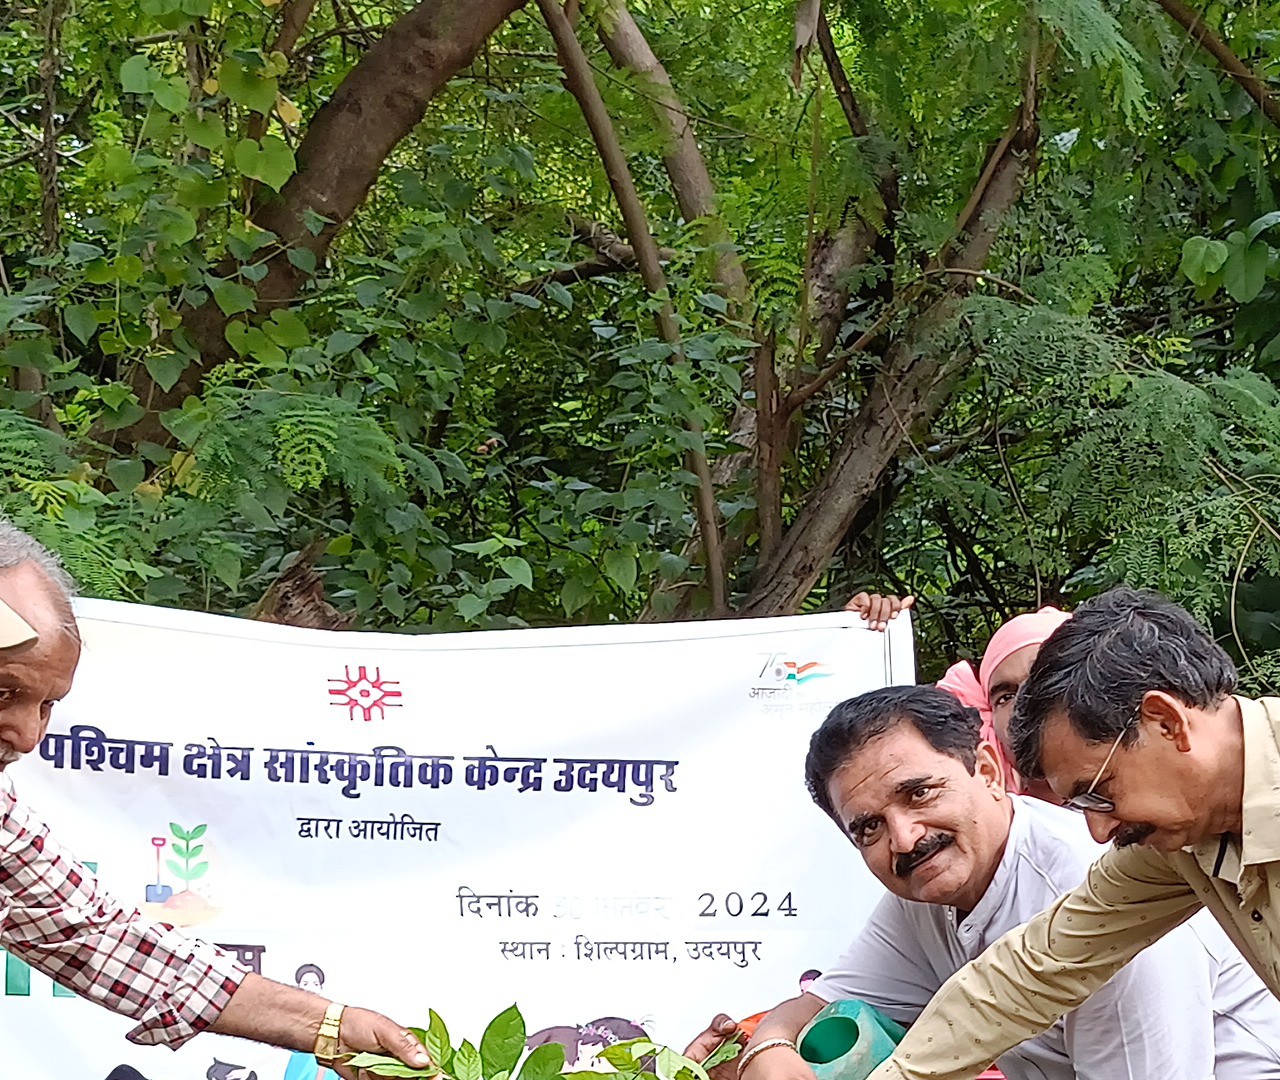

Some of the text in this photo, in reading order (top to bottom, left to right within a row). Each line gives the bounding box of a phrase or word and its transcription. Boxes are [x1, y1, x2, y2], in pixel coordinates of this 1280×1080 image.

[39, 724, 680, 807] पश्चिम क्षेत्र सांस्कृतिक केन्द्र उदयपुर
[296, 813, 442, 842] द्वारा आयोजित
[455, 885, 540, 919] दिनांक
[697, 891, 799, 918] 2024
[499, 941, 552, 961] स्थान
[574, 935, 677, 964] शिल्पग्राम,
[684, 941, 763, 969] उदयपुर
